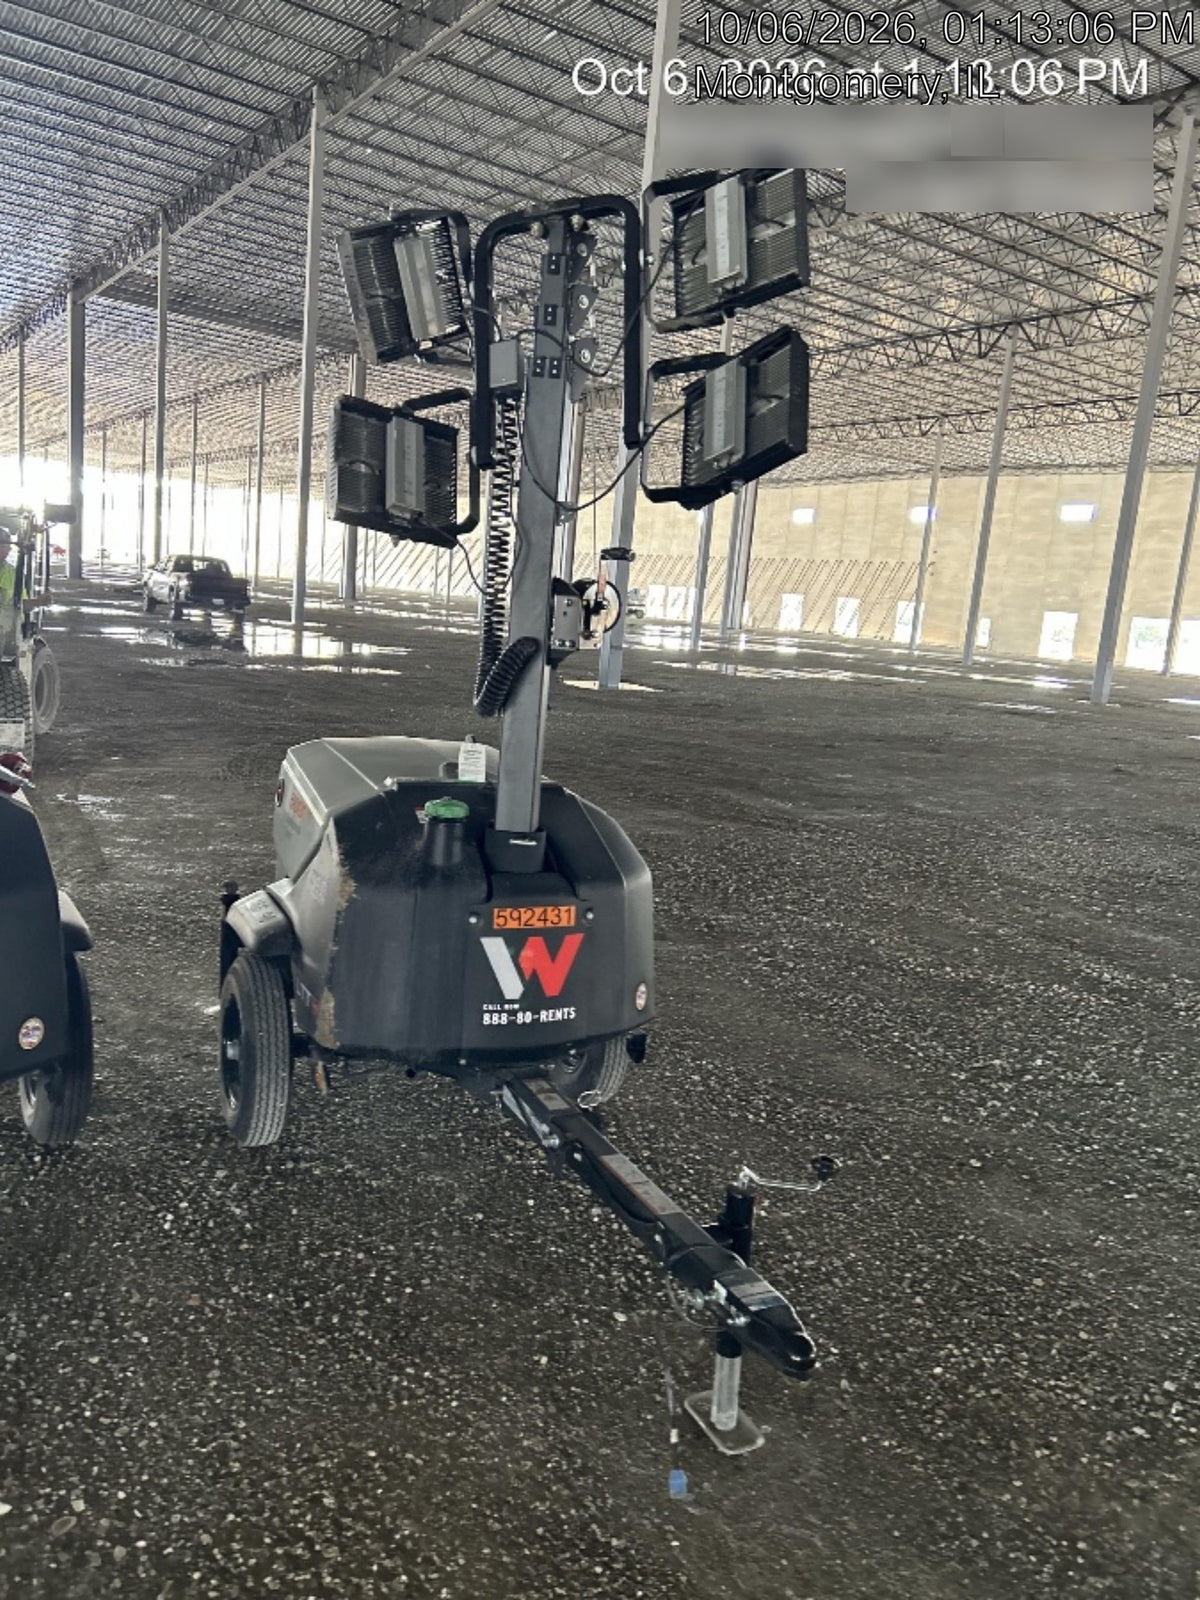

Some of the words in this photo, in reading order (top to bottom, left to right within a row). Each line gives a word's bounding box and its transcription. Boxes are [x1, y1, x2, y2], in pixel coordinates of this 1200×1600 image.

[495, 907, 575, 928] 592431
[482, 1003, 502, 1011] CALL
[482, 1006, 577, 1025] 888-80-RENTS
